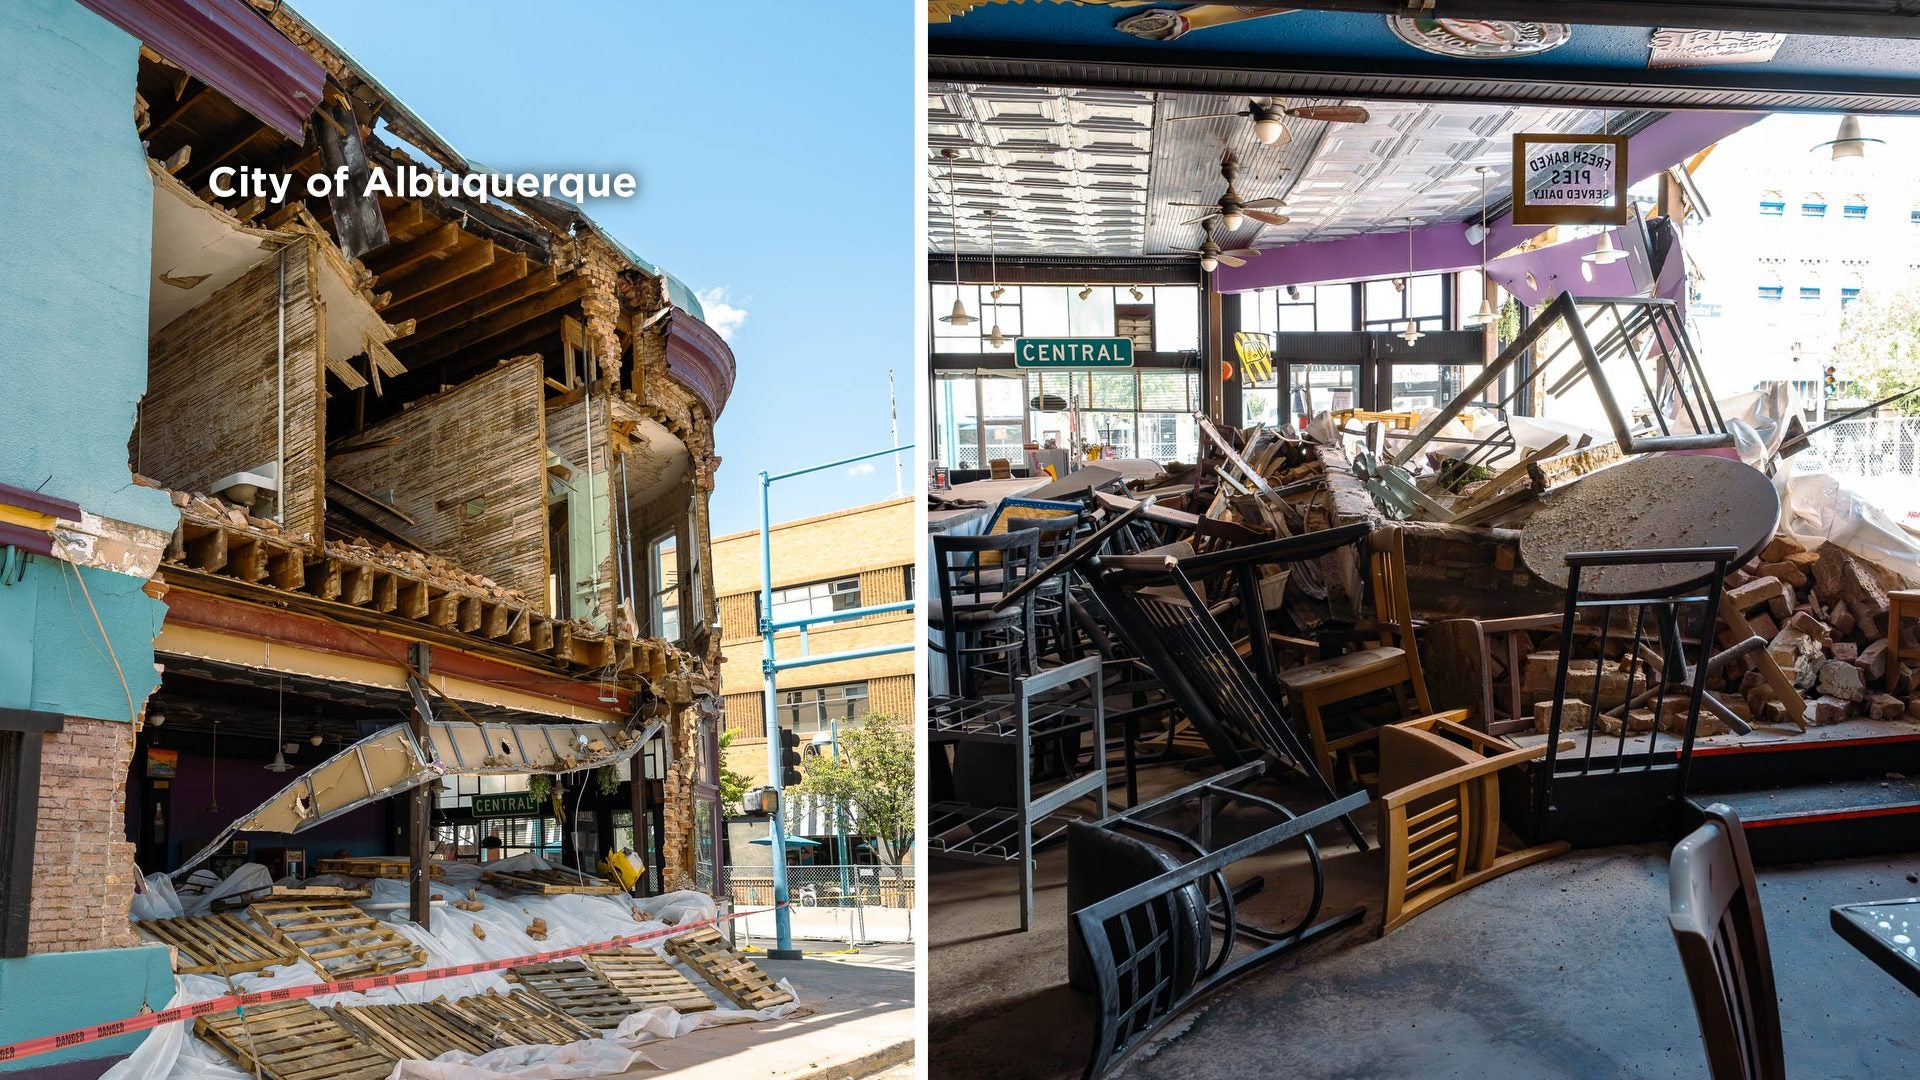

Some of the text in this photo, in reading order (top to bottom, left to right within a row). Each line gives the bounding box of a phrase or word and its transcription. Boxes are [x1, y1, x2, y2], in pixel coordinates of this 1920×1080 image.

[1023, 344, 1125, 361] CENTRAL
[476, 797, 534, 812] CENTRAL
[55, 1031, 85, 1047] DANGER
[97, 1022, 125, 1038] DANGER
[157, 1009, 182, 1024] DANGER
[191, 1002, 215, 1015] DANGER
